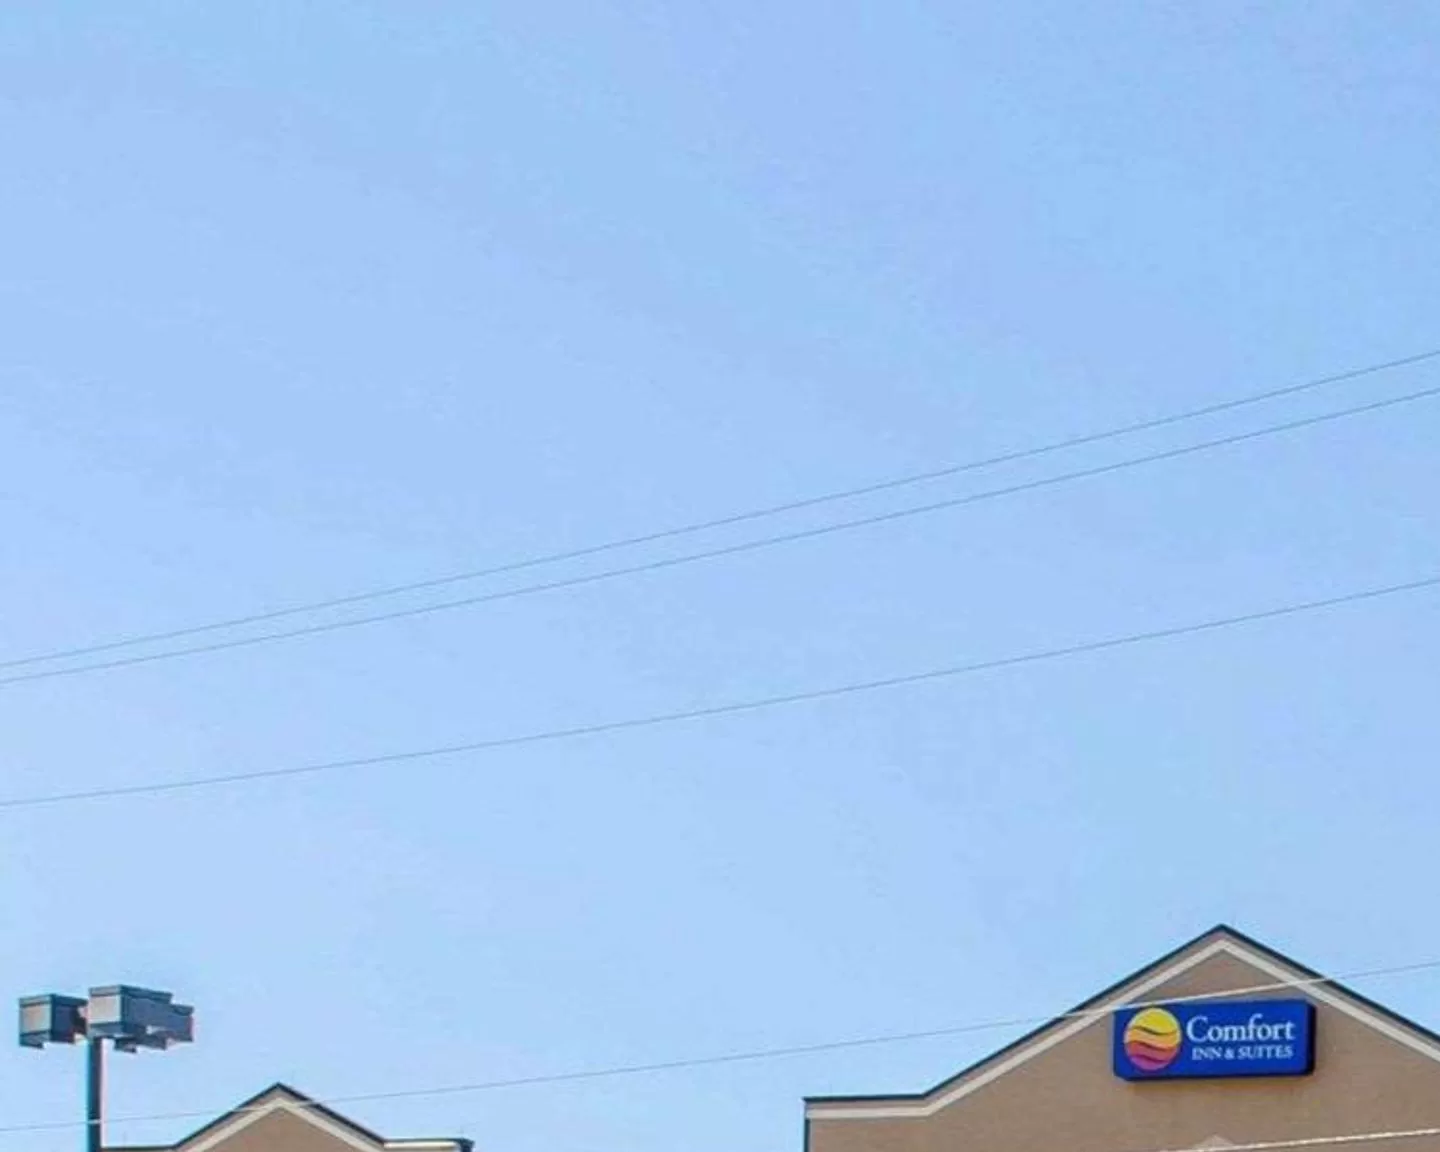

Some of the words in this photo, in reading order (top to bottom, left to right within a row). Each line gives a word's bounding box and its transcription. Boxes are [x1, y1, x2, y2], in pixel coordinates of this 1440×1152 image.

[1186, 1013, 1295, 1042] Comfort
[1191, 1045, 1222, 1060] INN
[1224, 1046, 1234, 1060] &
[1238, 1044, 1293, 1060] SUITES
